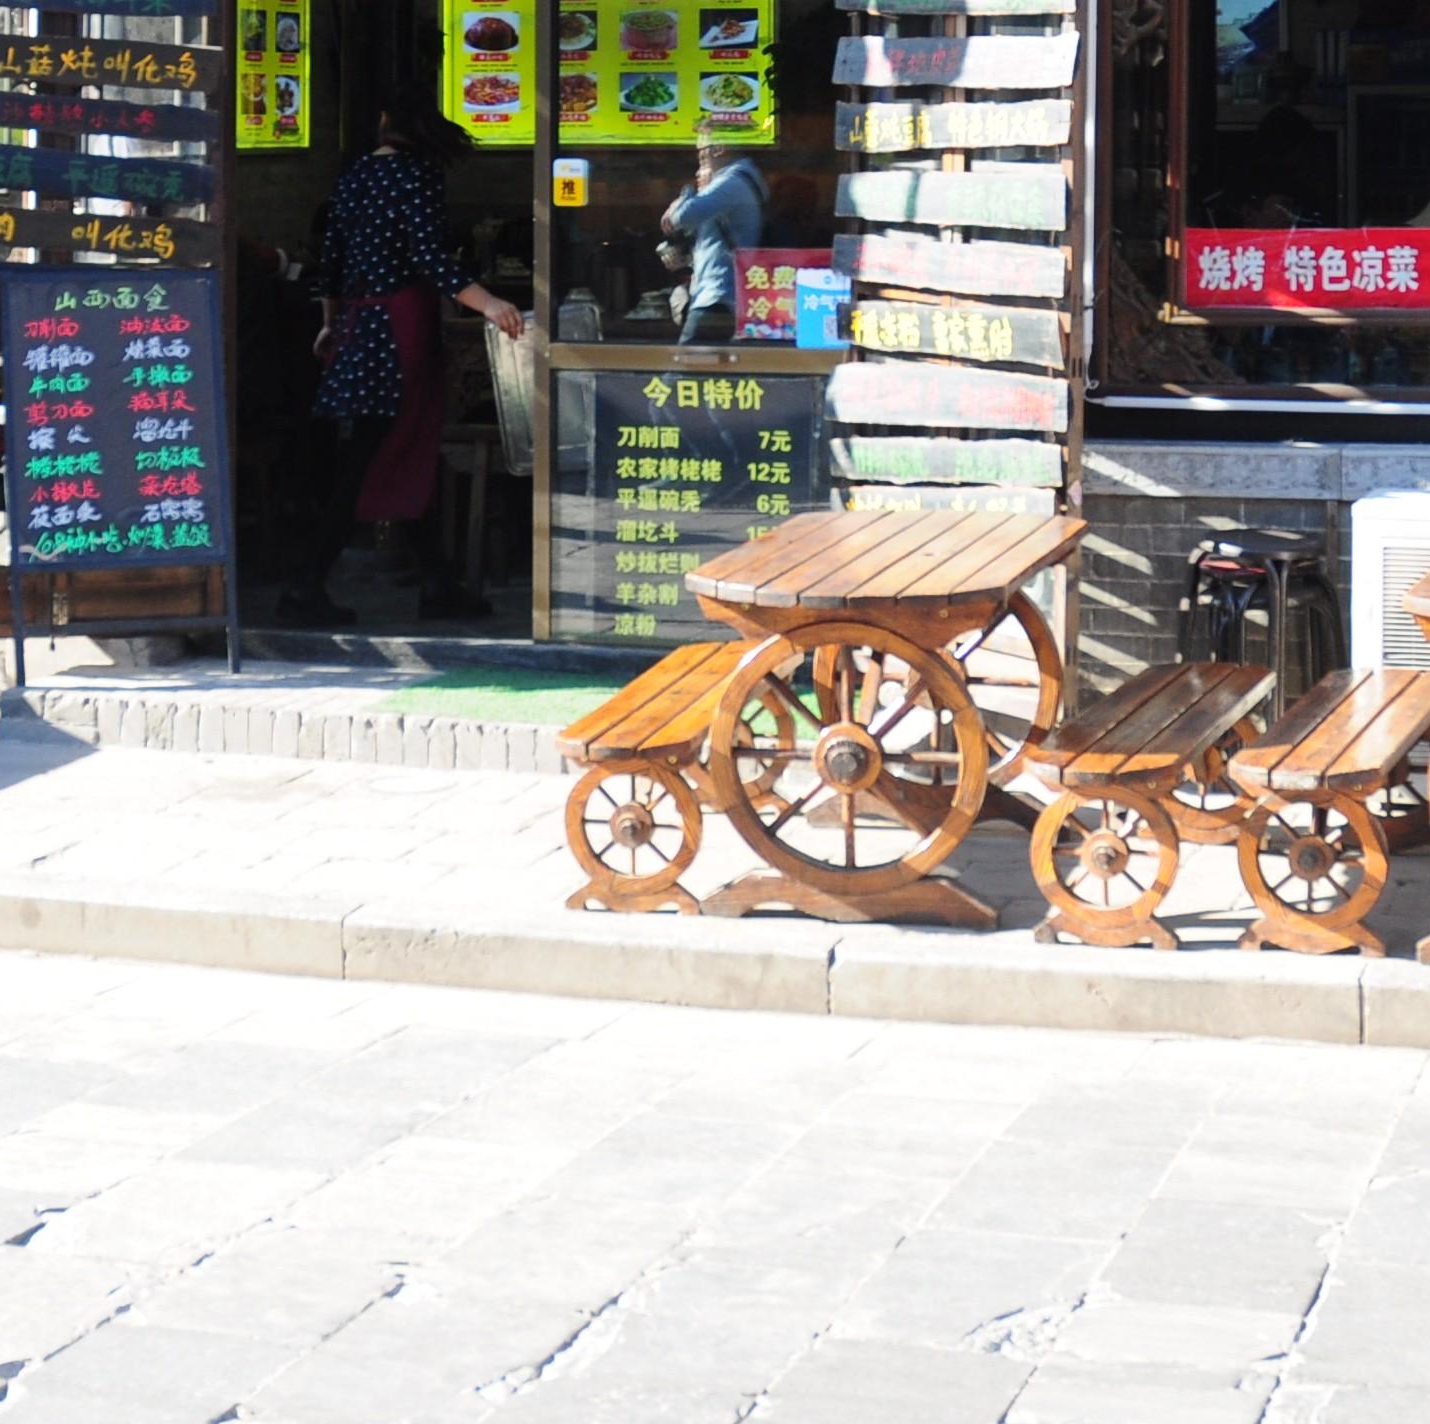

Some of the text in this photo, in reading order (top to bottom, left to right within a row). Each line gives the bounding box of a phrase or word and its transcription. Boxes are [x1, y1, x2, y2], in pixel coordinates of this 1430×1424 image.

[71, 219, 176, 260] 叫化鸡
[1197, 245, 1266, 293] 烧烤
[1283, 245, 1420, 293] 特色凉菜
[642, 376, 766, 411] 今日特价
[617, 426, 793, 453] 刀削面 7元
[746, 462, 792, 484] 12元
[756, 494, 791, 516] 6元
